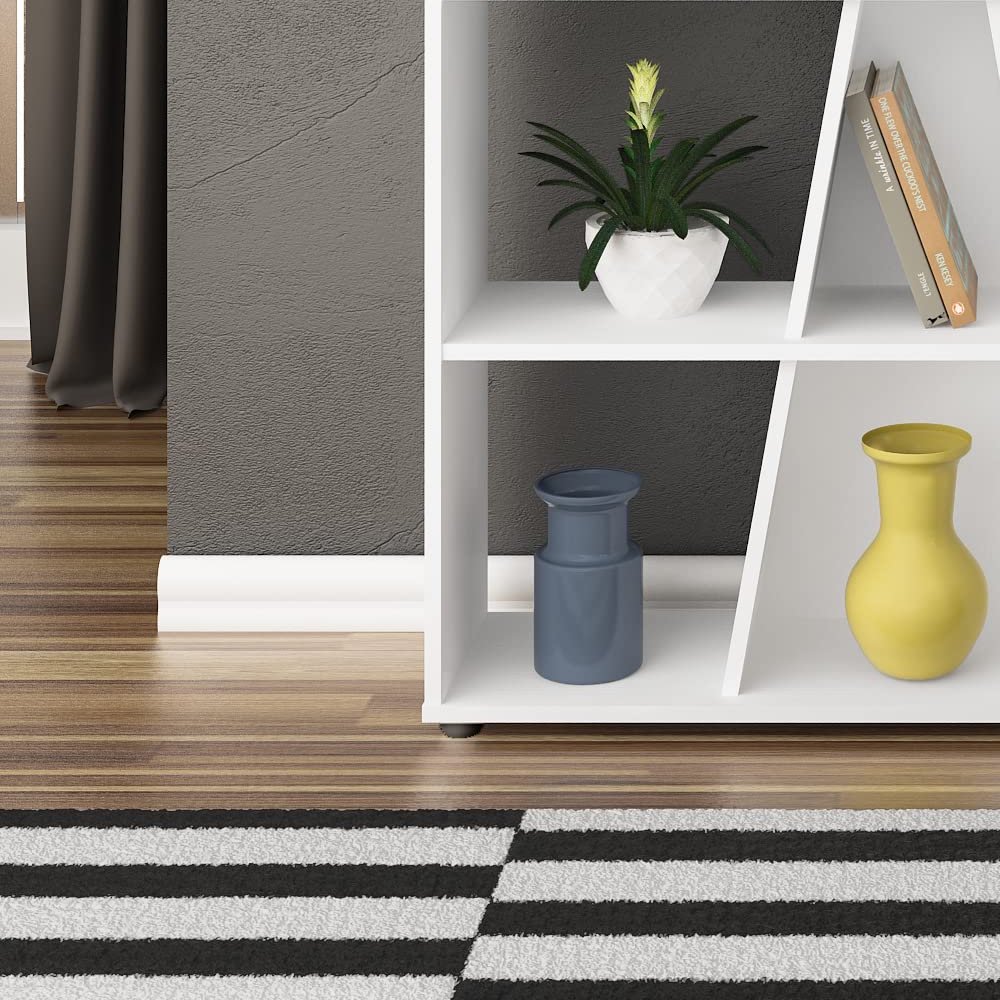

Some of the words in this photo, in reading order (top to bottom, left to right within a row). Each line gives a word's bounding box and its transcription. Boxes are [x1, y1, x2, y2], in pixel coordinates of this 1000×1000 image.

[878, 97, 890, 112] ONE
[861, 117, 875, 140] TIME
[883, 111, 897, 130] FLEW
[869, 140, 879, 150] IN
[891, 130, 903, 148] OVER
[896, 146, 909, 162] THE
[873, 151, 891, 183] wrinkle
[902, 161, 920, 196] CUCKOO'S
[914, 194, 926, 212] NEST
[934, 252, 946, 268] KEN
[940, 266, 954, 287] KESEY
